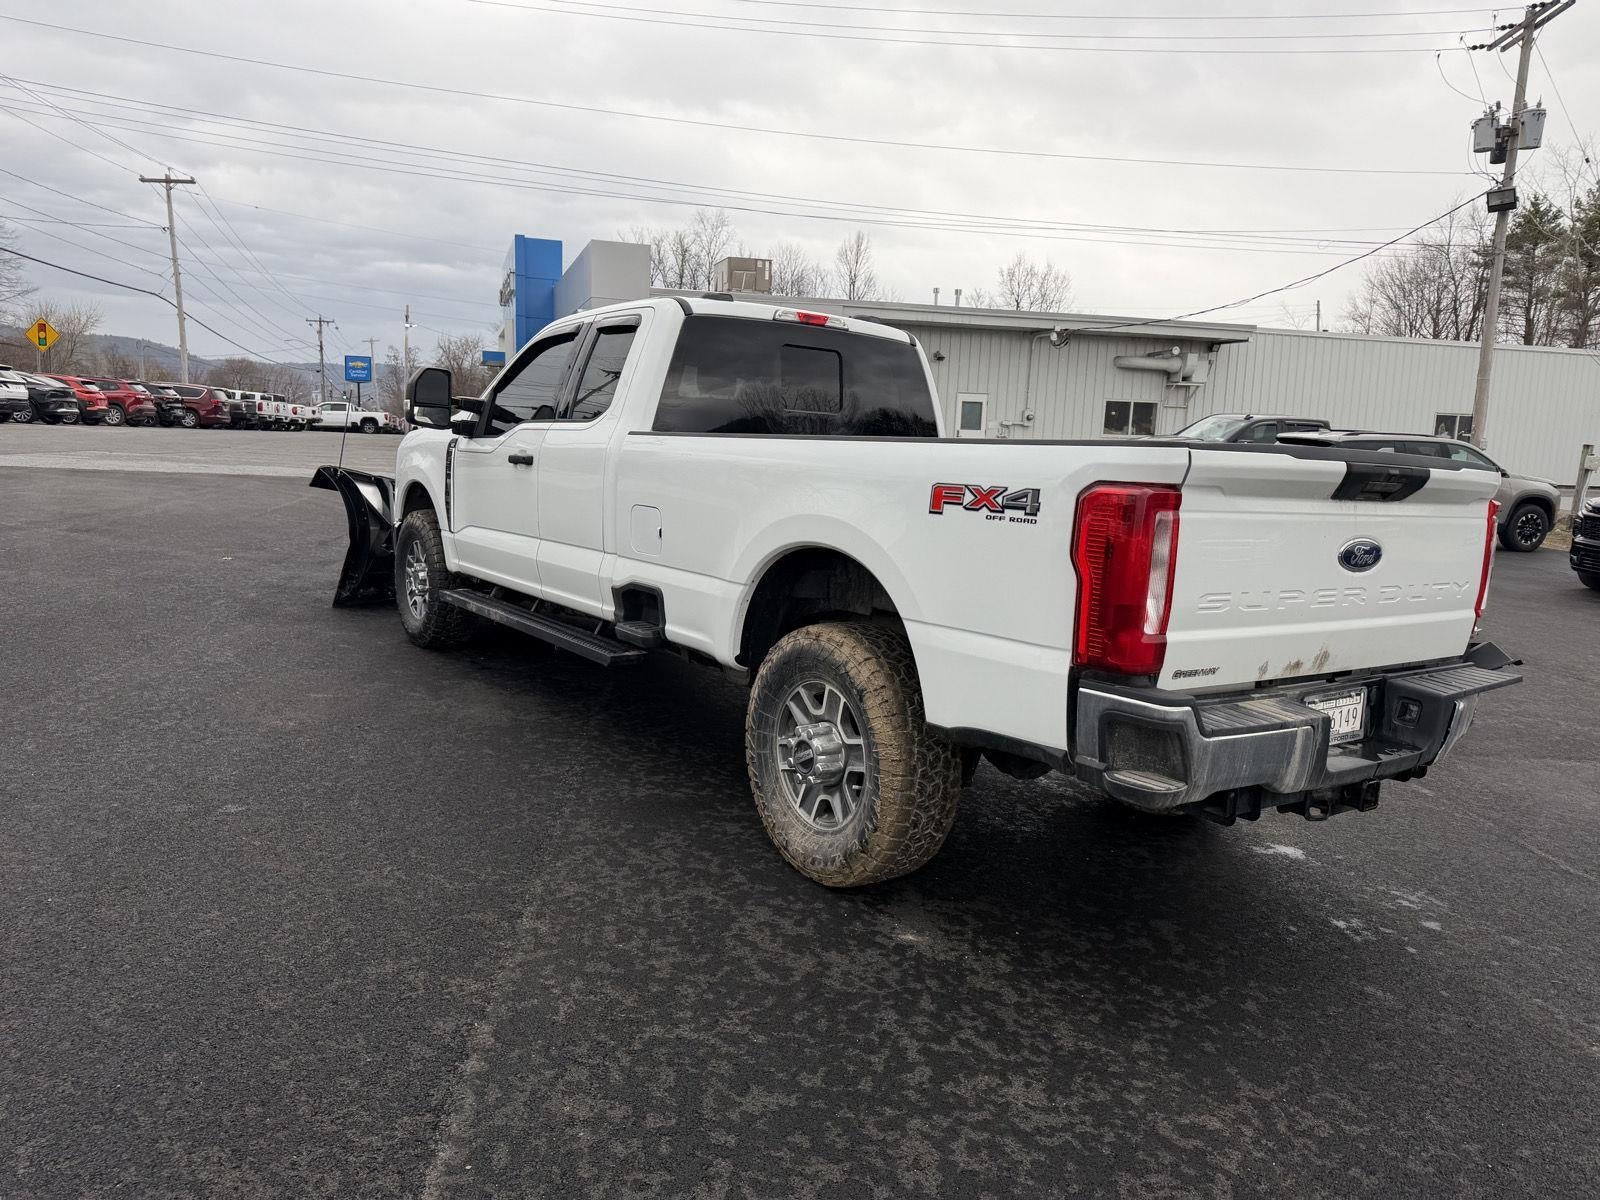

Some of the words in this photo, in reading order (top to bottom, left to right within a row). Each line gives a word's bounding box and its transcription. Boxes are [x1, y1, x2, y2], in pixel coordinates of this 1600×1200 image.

[929, 483, 1040, 516] FX4
[985, 514, 1006, 522] OFF
[1009, 516, 1038, 525] ROAD
[1196, 586, 1368, 614] SUPER
[1378, 580, 1471, 605] DUTY
[1327, 707, 1358, 730] 6149
